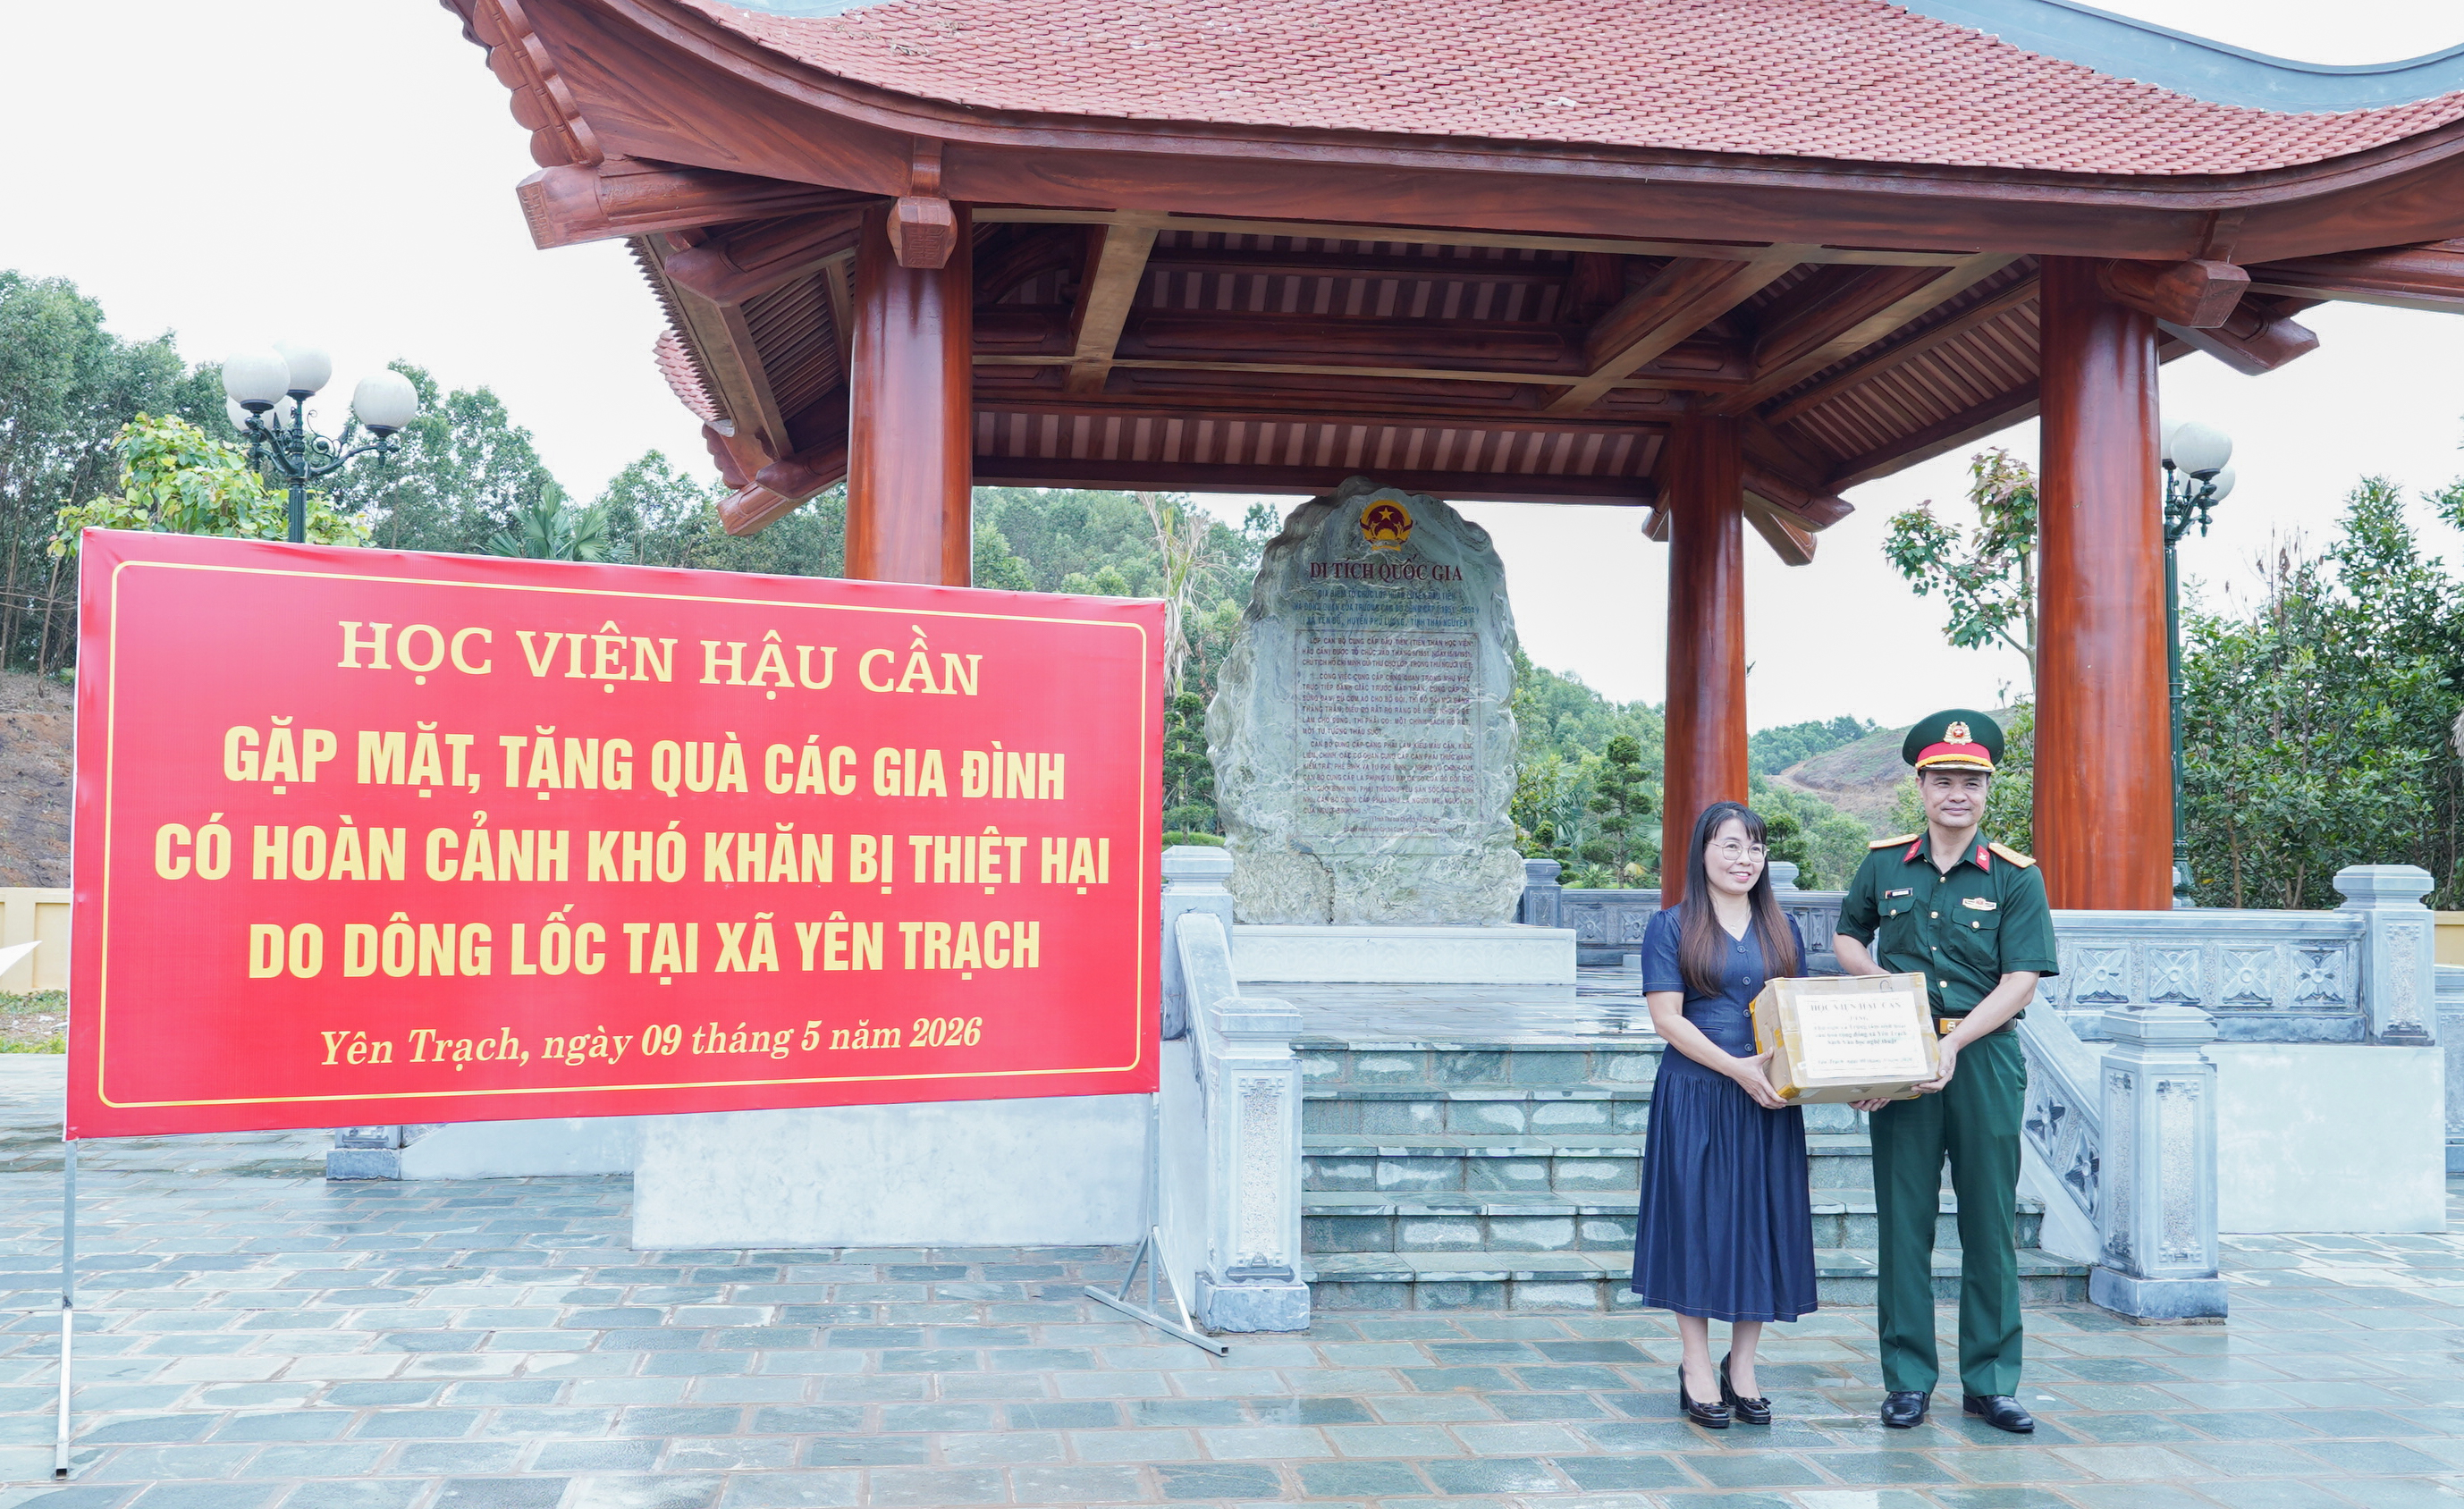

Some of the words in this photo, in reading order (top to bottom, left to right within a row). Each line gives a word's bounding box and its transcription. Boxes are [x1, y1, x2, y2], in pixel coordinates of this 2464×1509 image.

[1310, 561, 1328, 578] DI
[1332, 558, 1374, 579] TÍCH
[1378, 553, 1427, 582] QUỐC
[1431, 564, 1464, 581] GIA
[337, 620, 493, 686] HỌC
[515, 620, 679, 694] VIỆN
[699, 628, 838, 700] HẬU
[858, 624, 983, 696] CẦN
[224, 715, 337, 796] GẶP
[357, 721, 481, 798] MẶT,
[499, 724, 633, 801] TẶNG
[651, 731, 748, 798] QUÀ
[764, 734, 857, 796] CÁC
[873, 746, 948, 797] GIA
[960, 740, 1065, 800] ĐÌNH
[155, 812, 232, 881] CÓ
[252, 814, 407, 881] HOÀN
[426, 810, 570, 882] CẢNH
[587, 820, 687, 883] KHÓ
[704, 822, 834, 883] KHĂN
[849, 834, 894, 895] BỊ
[908, 825, 1028, 895] THIỆT
[1041, 837, 1110, 895] HẠI
[249, 923, 324, 979] DO
[343, 911, 493, 978] DÔNG
[511, 903, 606, 976] LỐC
[622, 922, 699, 986] TẠI
[714, 911, 780, 973] XÃ
[794, 910, 884, 972] YÊN
[899, 920, 1040, 981] TRẠCH
[320, 1031, 392, 1066] Yên
[409, 1026, 529, 1072] Trạch,
[541, 1024, 633, 1066] ngày
[641, 1024, 682, 1056] 09
[691, 1021, 794, 1060] tháng
[800, 1020, 822, 1051] 5
[829, 1019, 901, 1050] năm
[908, 1016, 983, 1048] 2026
